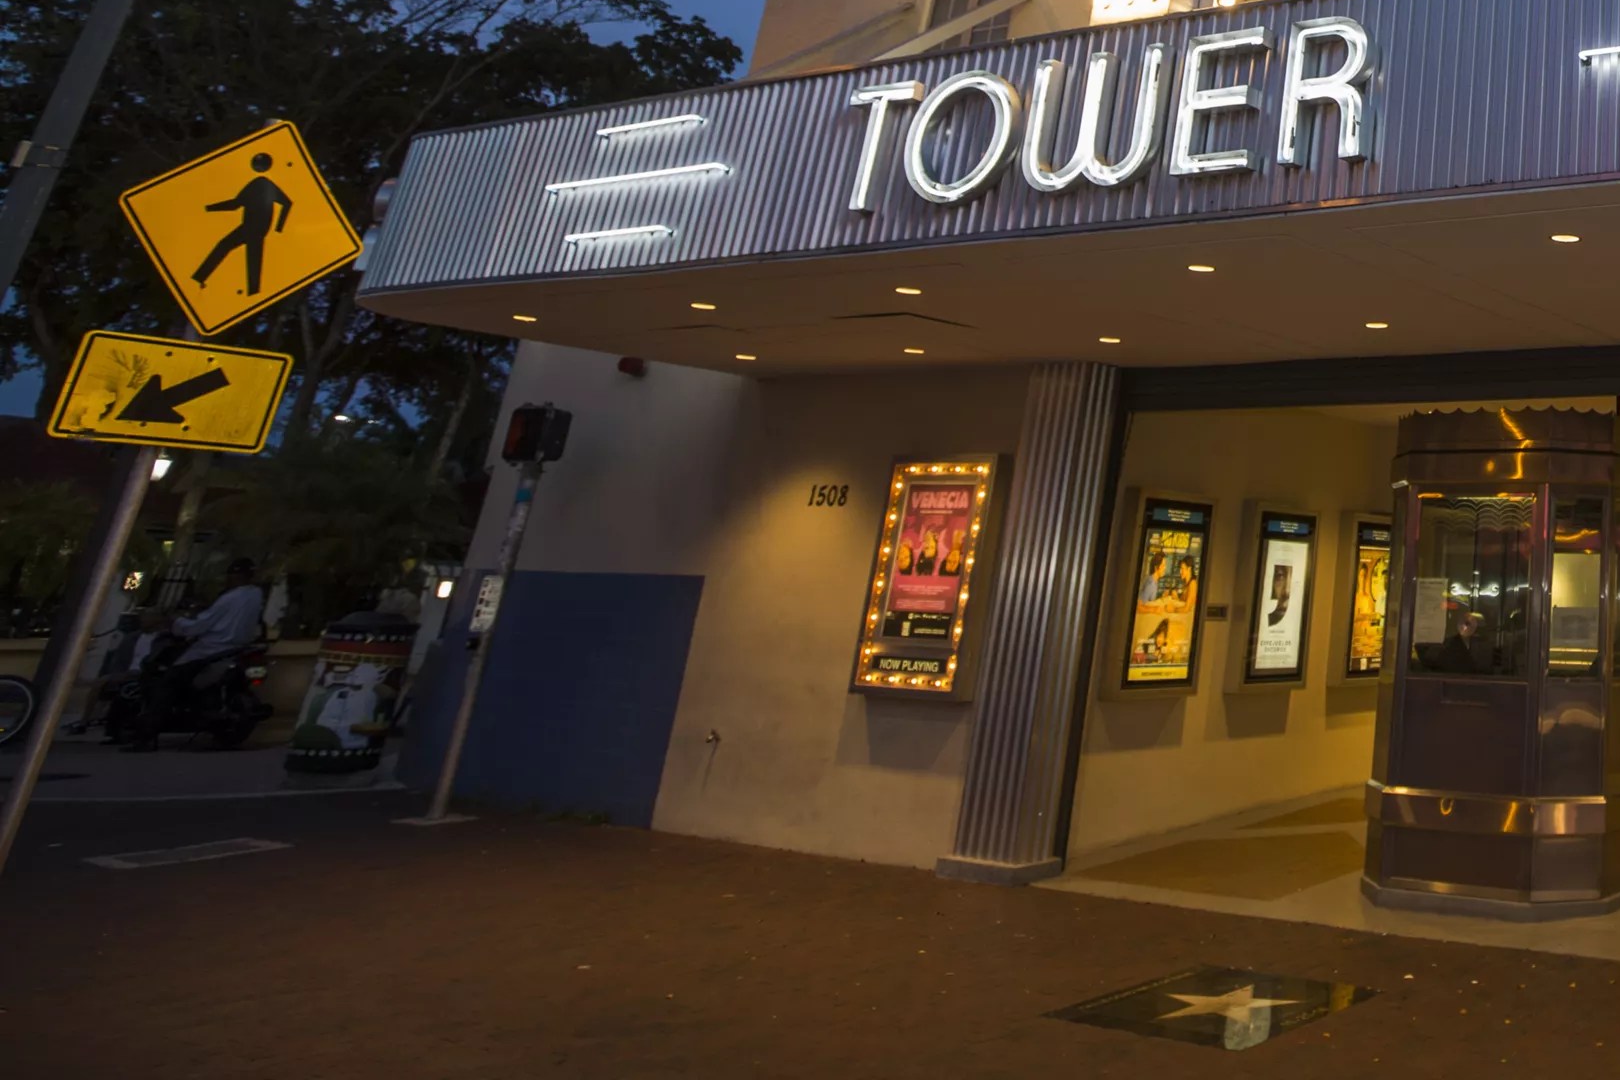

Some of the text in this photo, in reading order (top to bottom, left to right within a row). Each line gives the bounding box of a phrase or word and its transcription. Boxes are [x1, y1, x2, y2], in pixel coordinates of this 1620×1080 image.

[848, 15, 1378, 212] TOWER
[807, 484, 849, 507] 1508
[911, 490, 969, 509] VENECIA
[879, 657, 940, 673] NOW PLAYING
